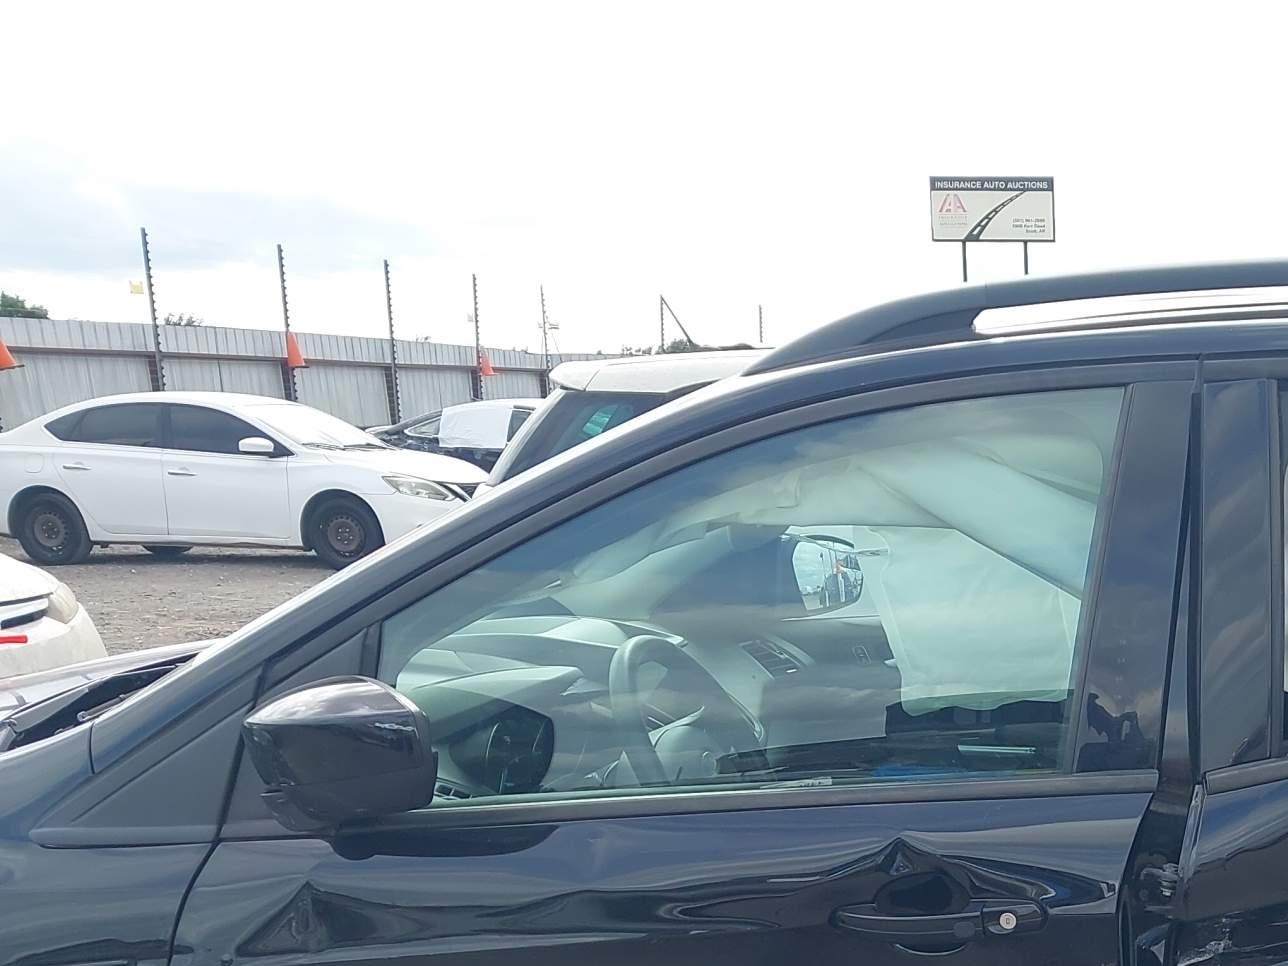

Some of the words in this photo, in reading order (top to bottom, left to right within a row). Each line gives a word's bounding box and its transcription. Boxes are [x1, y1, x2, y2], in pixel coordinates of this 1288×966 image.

[935, 181, 982, 189] INSURANCE
[983, 181, 1006, 189] AUTO
[1007, 181, 1048, 189] AUCTIONS
